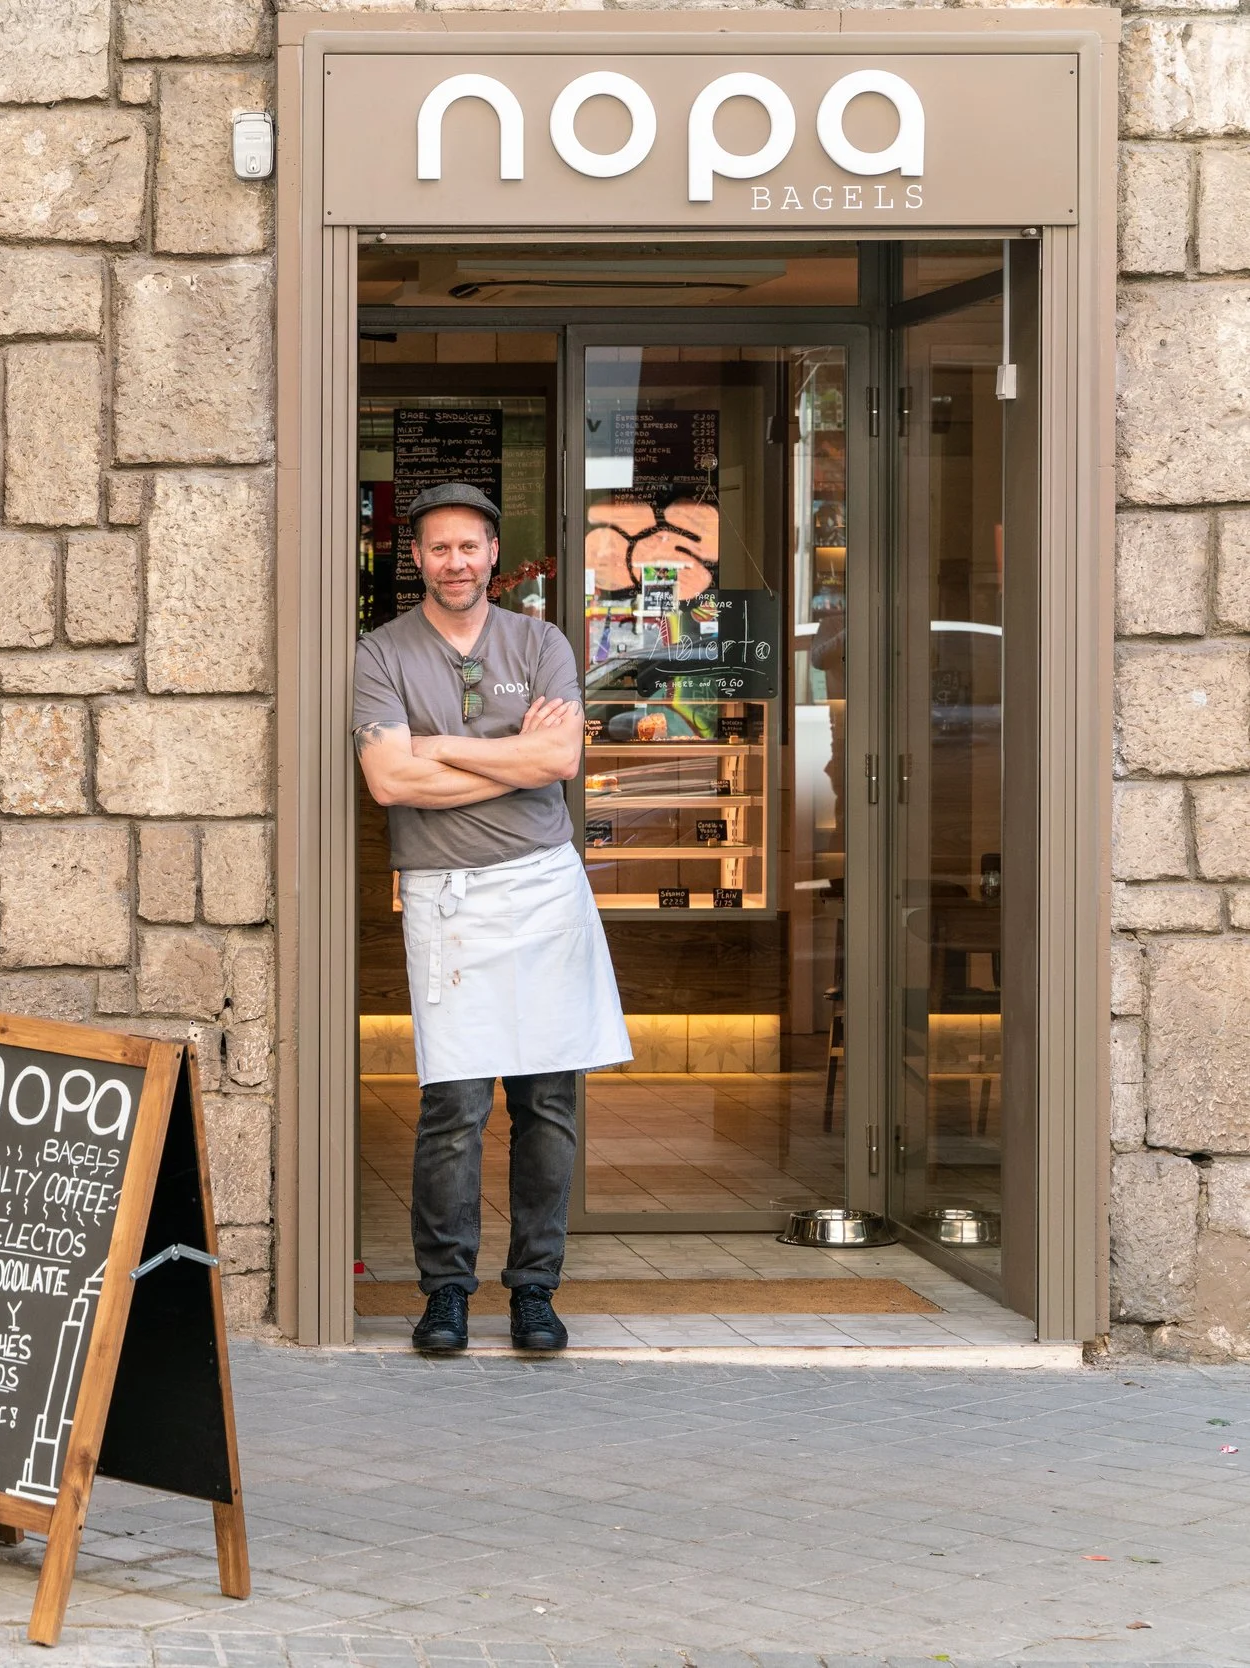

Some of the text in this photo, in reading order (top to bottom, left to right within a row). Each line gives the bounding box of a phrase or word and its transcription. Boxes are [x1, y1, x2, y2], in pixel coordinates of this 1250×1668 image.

[417, 69, 926, 203] nopa
[750, 184, 925, 210] BAGELS
[695, 592, 716, 600] PARA
[654, 680, 668, 688] FOR
[671, 680, 694, 688] HERE
[715, 678, 728, 688] TO
[729, 678, 744, 688] GO
[43, 1139, 121, 1168] BAGELS
[43, 1172, 114, 1215] COFFEE
[6, 1301, 22, 1329] Y
